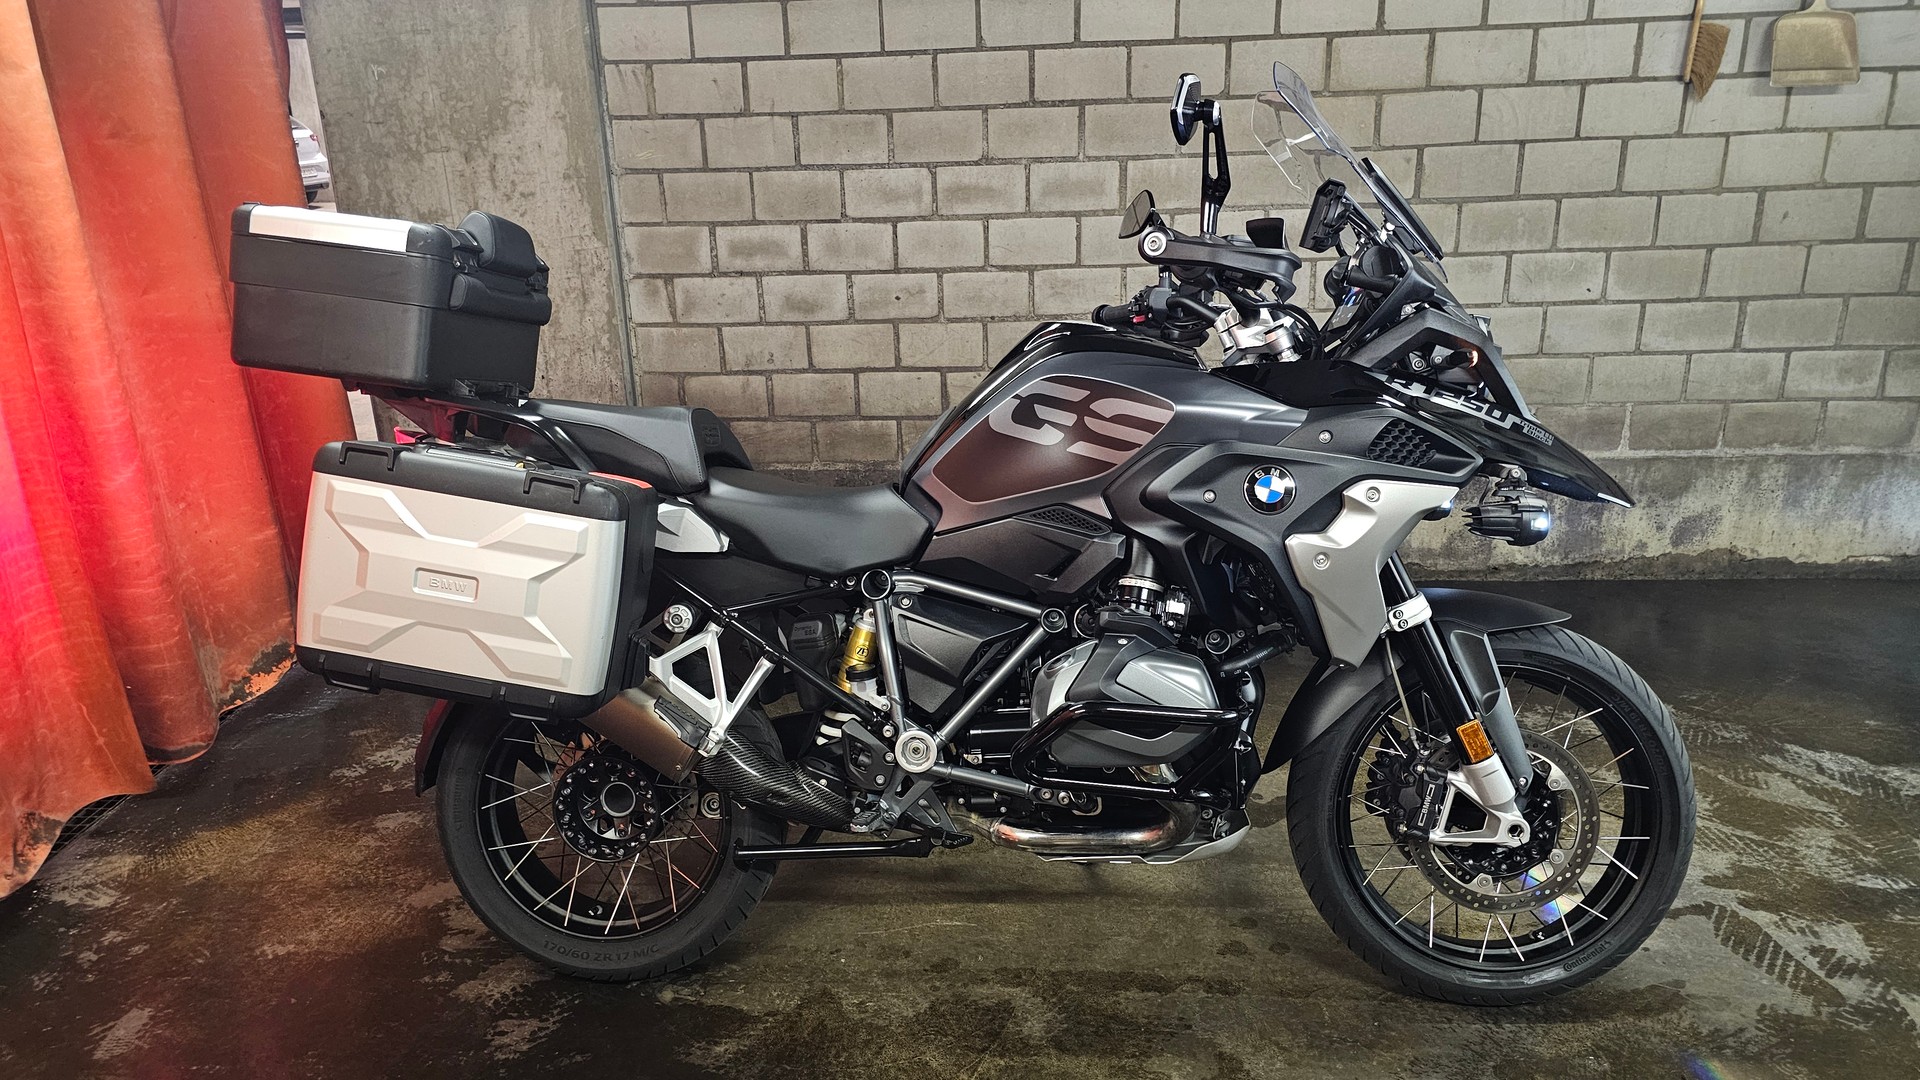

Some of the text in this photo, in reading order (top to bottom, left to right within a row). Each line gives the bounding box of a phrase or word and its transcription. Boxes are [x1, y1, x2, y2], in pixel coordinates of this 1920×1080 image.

[989, 379, 1175, 465] GS
[429, 576, 467, 592] BMW
[1421, 795, 1432, 814] BMW
[543, 940, 660, 962] 170/60 ZR 17 M/C
[1563, 943, 1608, 972] Continental
